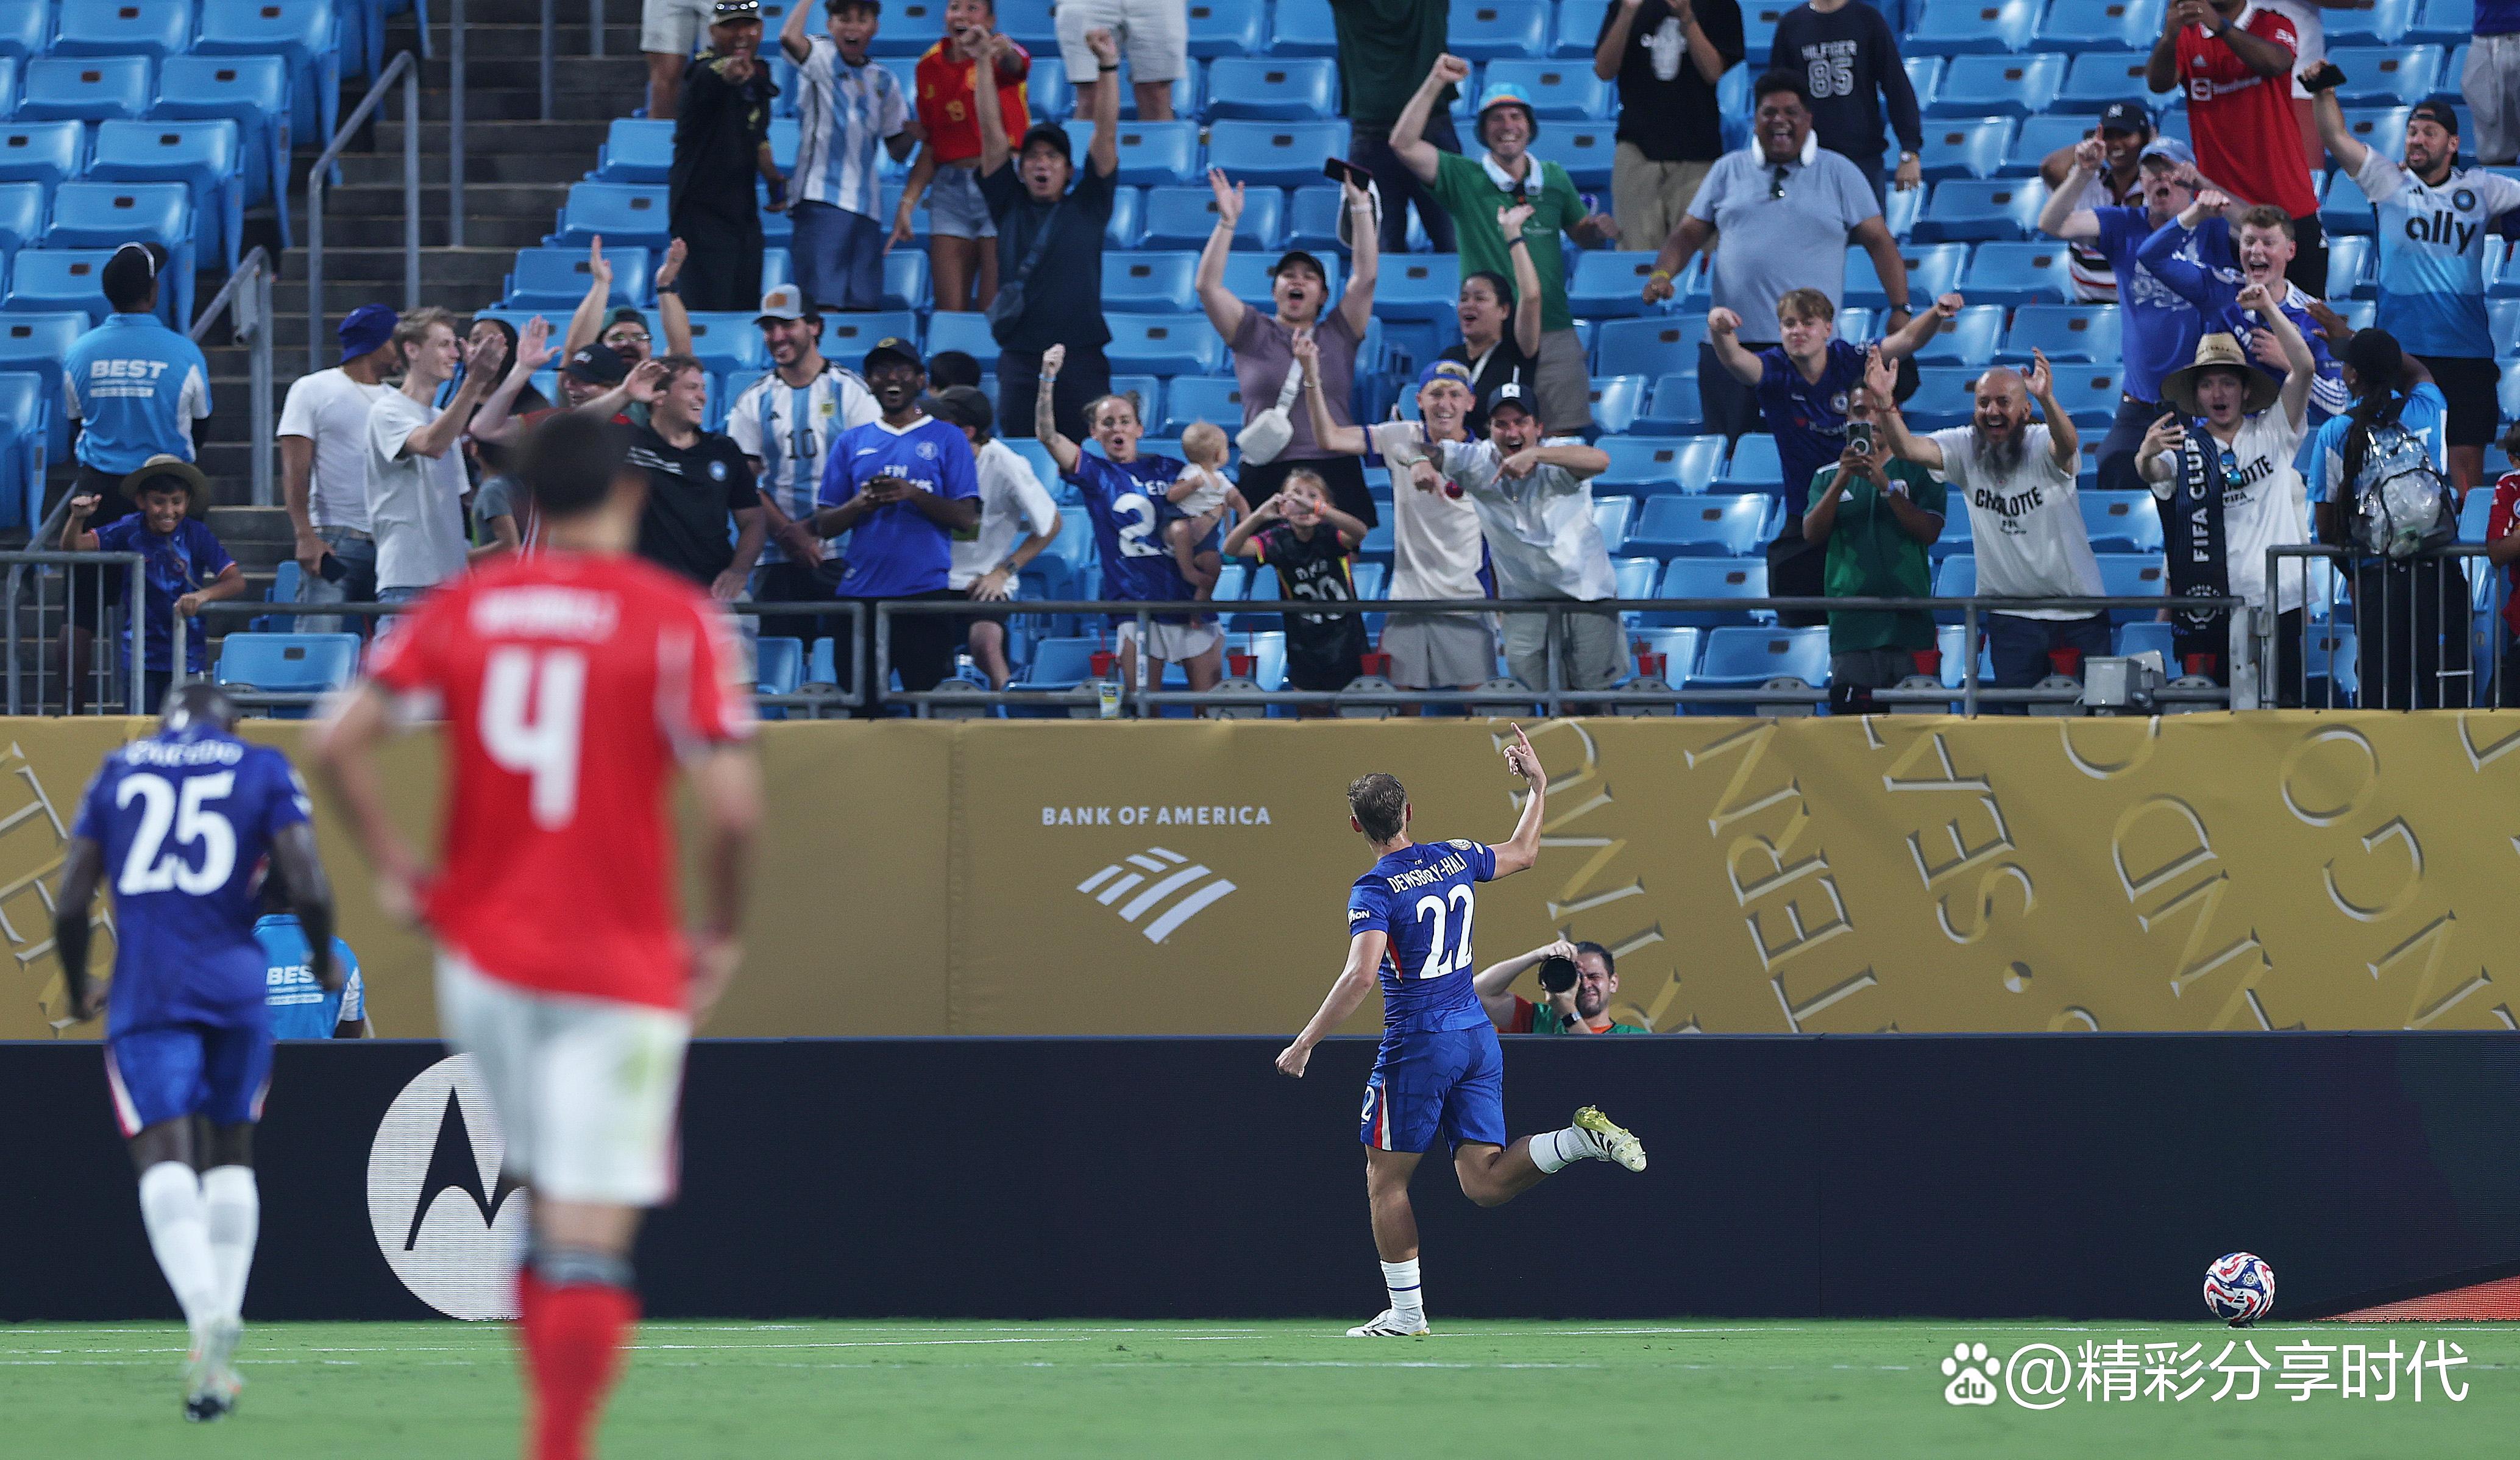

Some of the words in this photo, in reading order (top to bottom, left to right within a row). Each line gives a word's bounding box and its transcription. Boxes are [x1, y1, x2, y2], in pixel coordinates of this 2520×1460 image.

[1808, 59, 1853, 98] 85
[2405, 210, 2476, 255] ally
[91, 359, 169, 379] BEST
[786, 428, 818, 459] 10
[2184, 436, 2207, 501] CLUB
[2192, 507, 2210, 562] FIFA
[481, 644, 587, 832] 4
[116, 771, 238, 896] 25
[1042, 806, 1112, 826] BANK
[1118, 806, 1151, 826] OF
[1156, 806, 1272, 826] AMERICA
[1416, 884, 1475, 979] 22
[266, 966, 316, 985] BES
